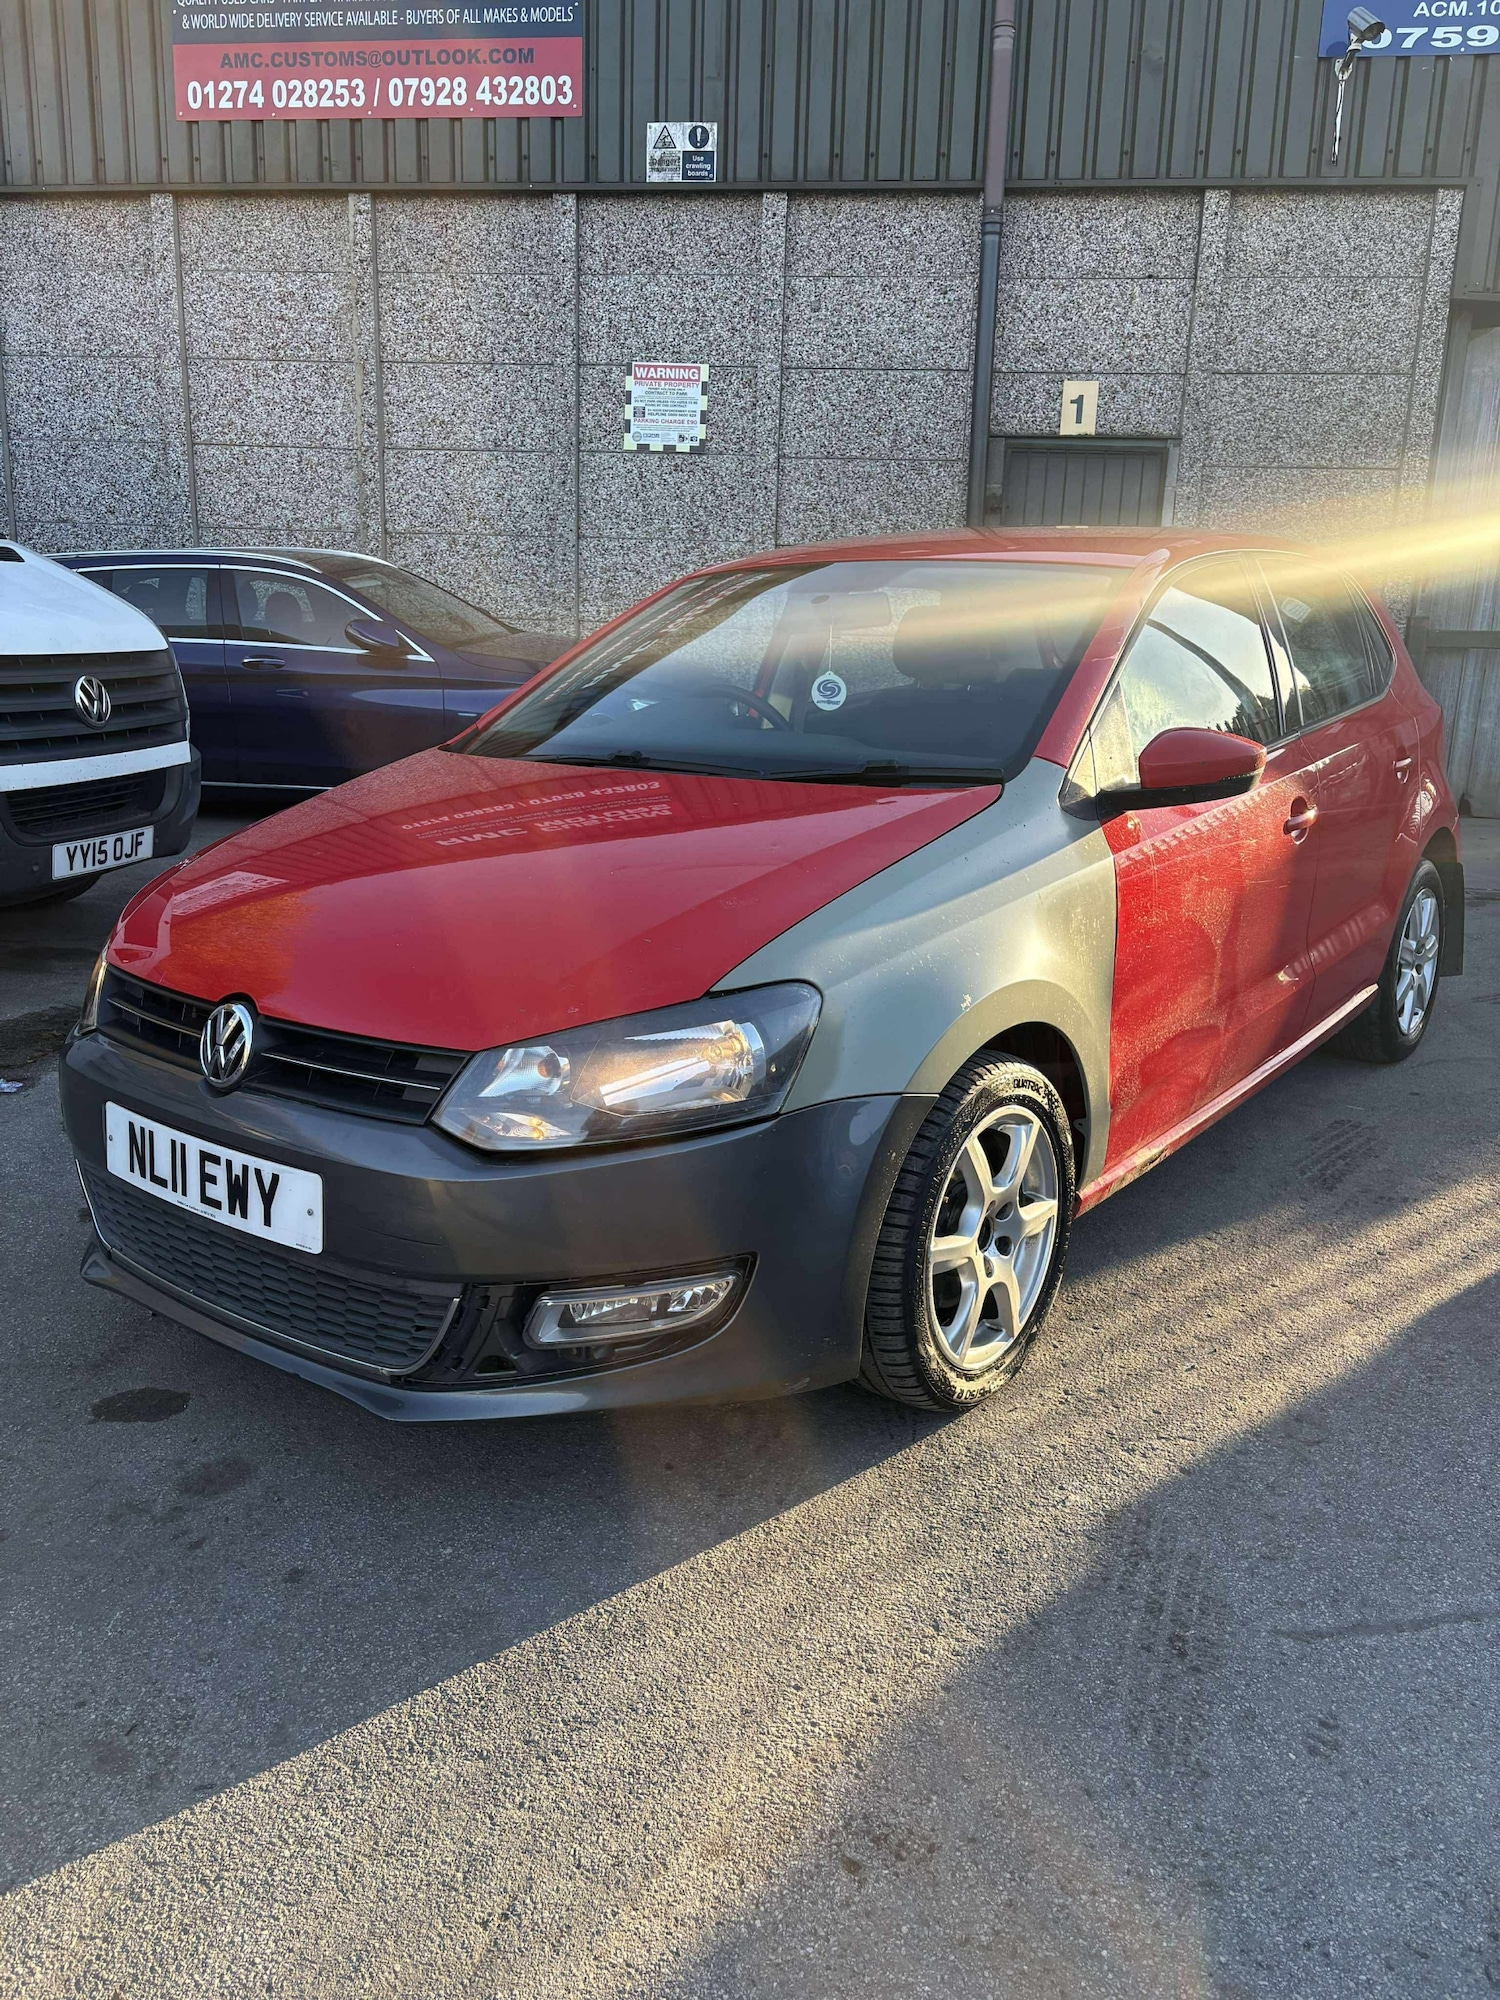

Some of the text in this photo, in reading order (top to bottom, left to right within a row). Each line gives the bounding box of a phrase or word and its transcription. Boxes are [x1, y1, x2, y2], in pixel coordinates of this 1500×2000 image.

[182, 14, 190, 29] &
[191, 13, 227, 29] WORLD
[228, 13, 255, 29] WIDE
[256, 12, 302, 28] DELIVERY
[304, 11, 344, 27] SERVICE
[346, 9, 398, 26] AVAILABLE
[406, 9, 444, 25] BUYERS
[446, 8, 460, 24] OF
[462, 8, 481, 24] ALL
[483, 7, 518, 24] MAKES
[520, 7, 528, 23] &
[530, 6, 574, 23] MODELS
[220, 47, 535, 68] AMC.CUSTOMS@OUTLOOK.COM
[187, 75, 573, 109] 01274 028253 / 07928 432803
[635, 367, 699, 380] WARNING
[664, 381, 700, 389] PROPERTY
[1070, 394, 1084, 424] 1
[66, 831, 145, 871] YY15 OJF
[128, 1120, 280, 1228] NL11 EWY
